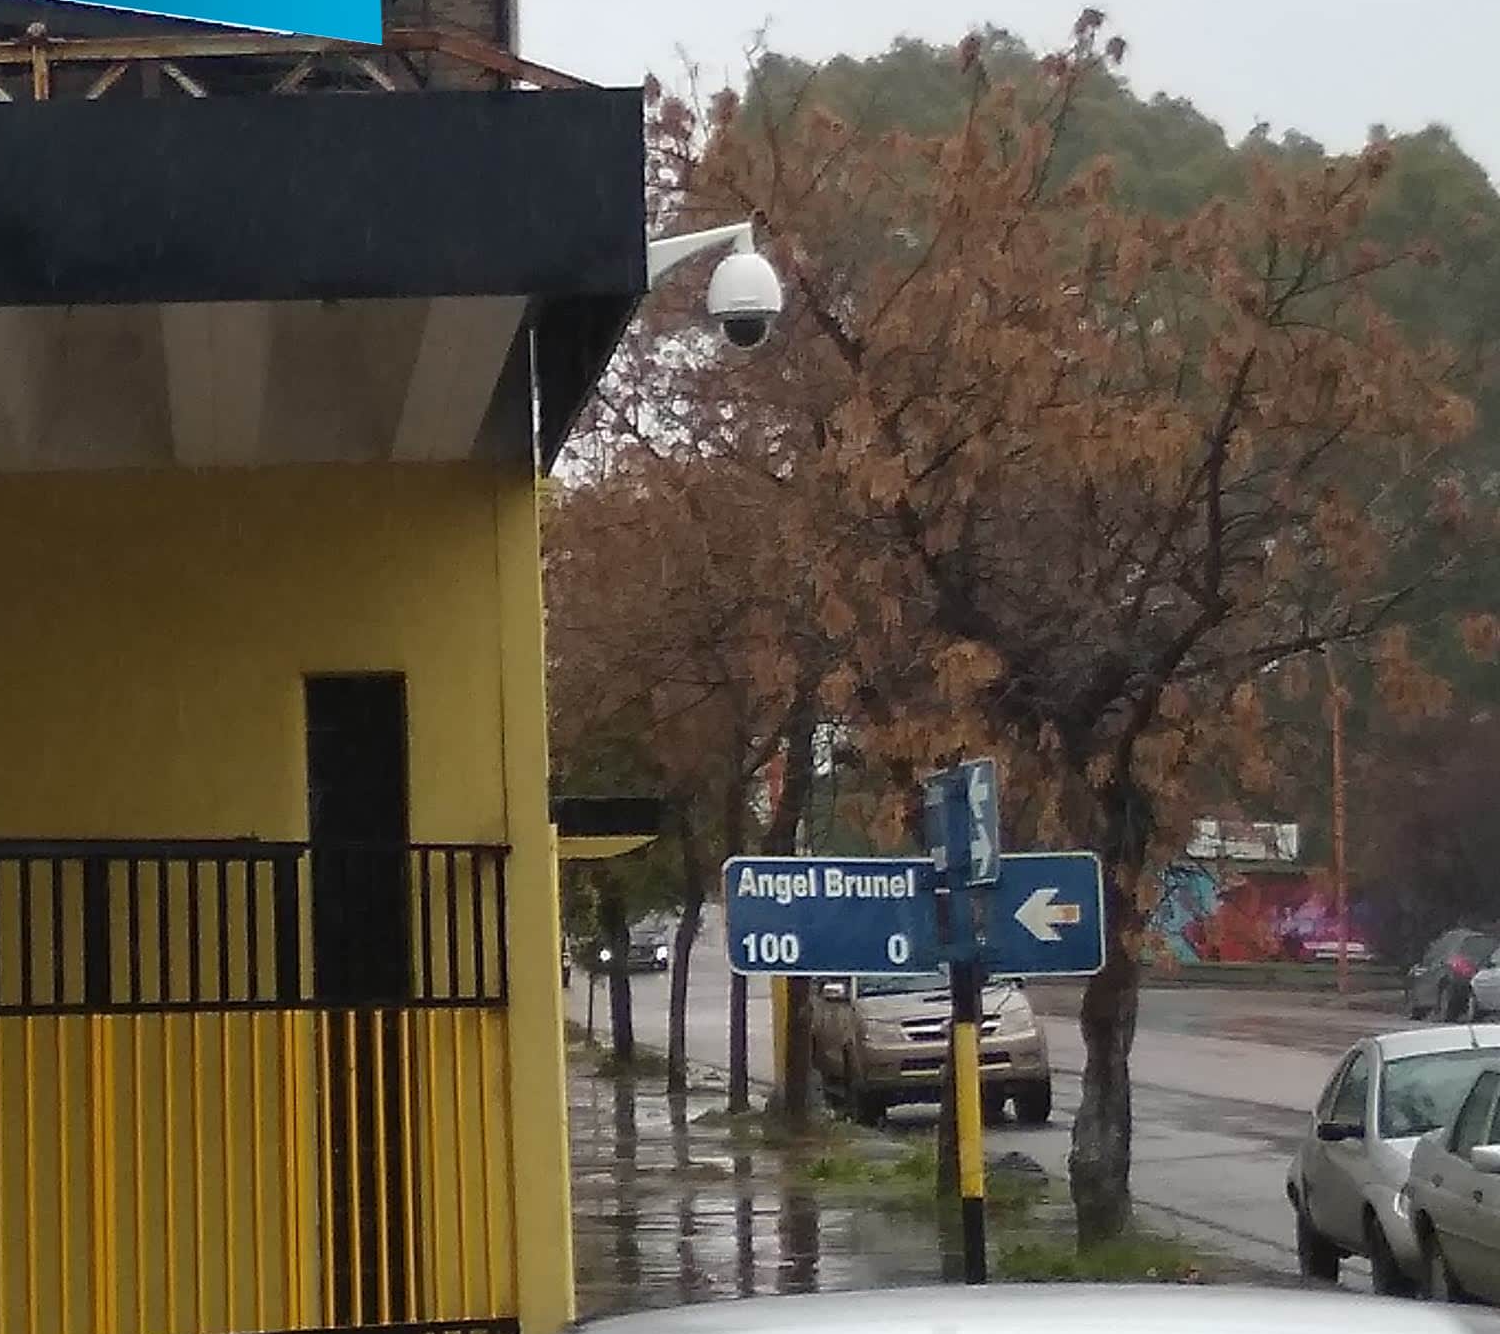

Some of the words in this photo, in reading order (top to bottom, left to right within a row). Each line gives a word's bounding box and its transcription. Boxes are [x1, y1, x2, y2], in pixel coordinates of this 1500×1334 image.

[737, 867, 816, 904] Angel
[824, 868, 915, 898] Brunel
[741, 933, 800, 965] 100
[887, 933, 909, 965] 0
